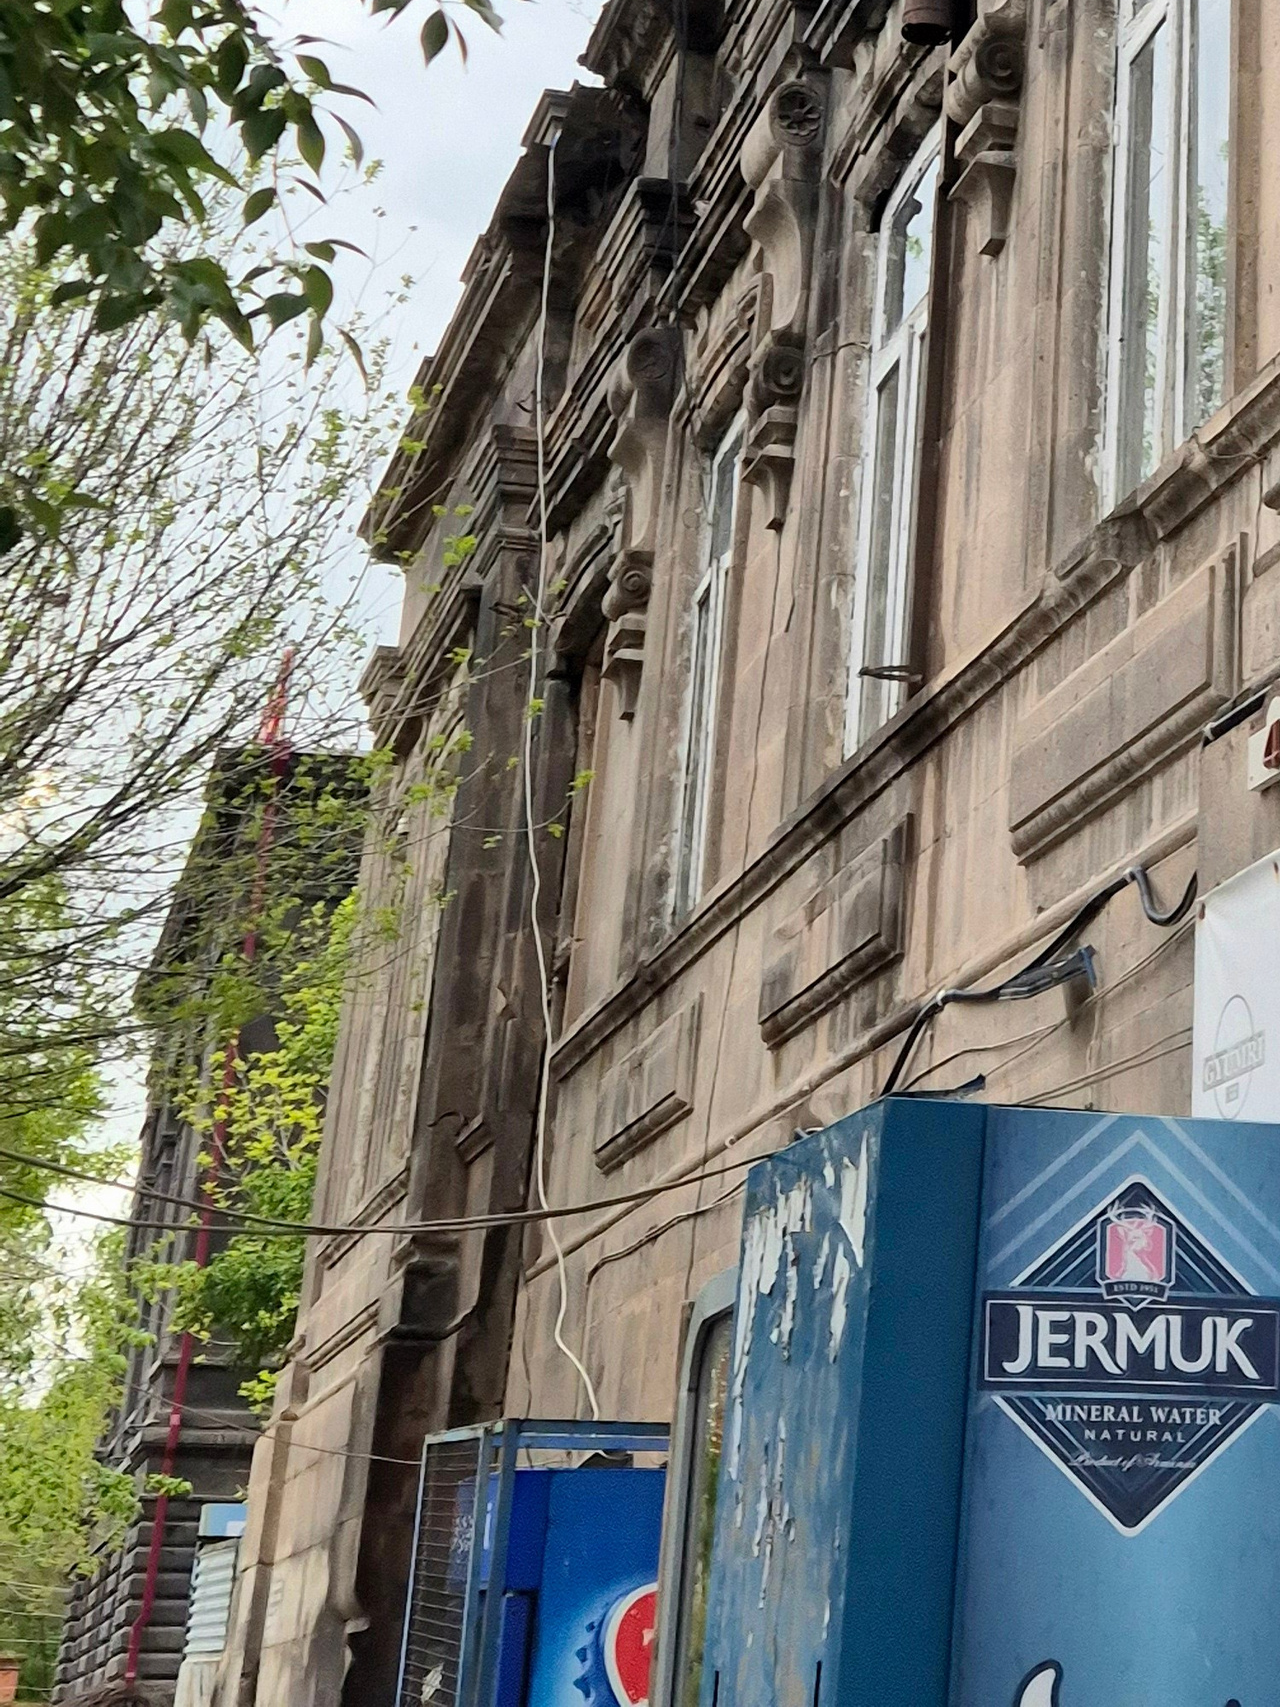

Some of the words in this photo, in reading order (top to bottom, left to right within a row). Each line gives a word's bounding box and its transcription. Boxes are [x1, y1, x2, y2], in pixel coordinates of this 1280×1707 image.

[1002, 1305, 1260, 1380] JERMUK
[1045, 1404, 1143, 1423] MINERAL
[1150, 1406, 1222, 1426] WATER
[1084, 1429, 1186, 1443] NATURAL
